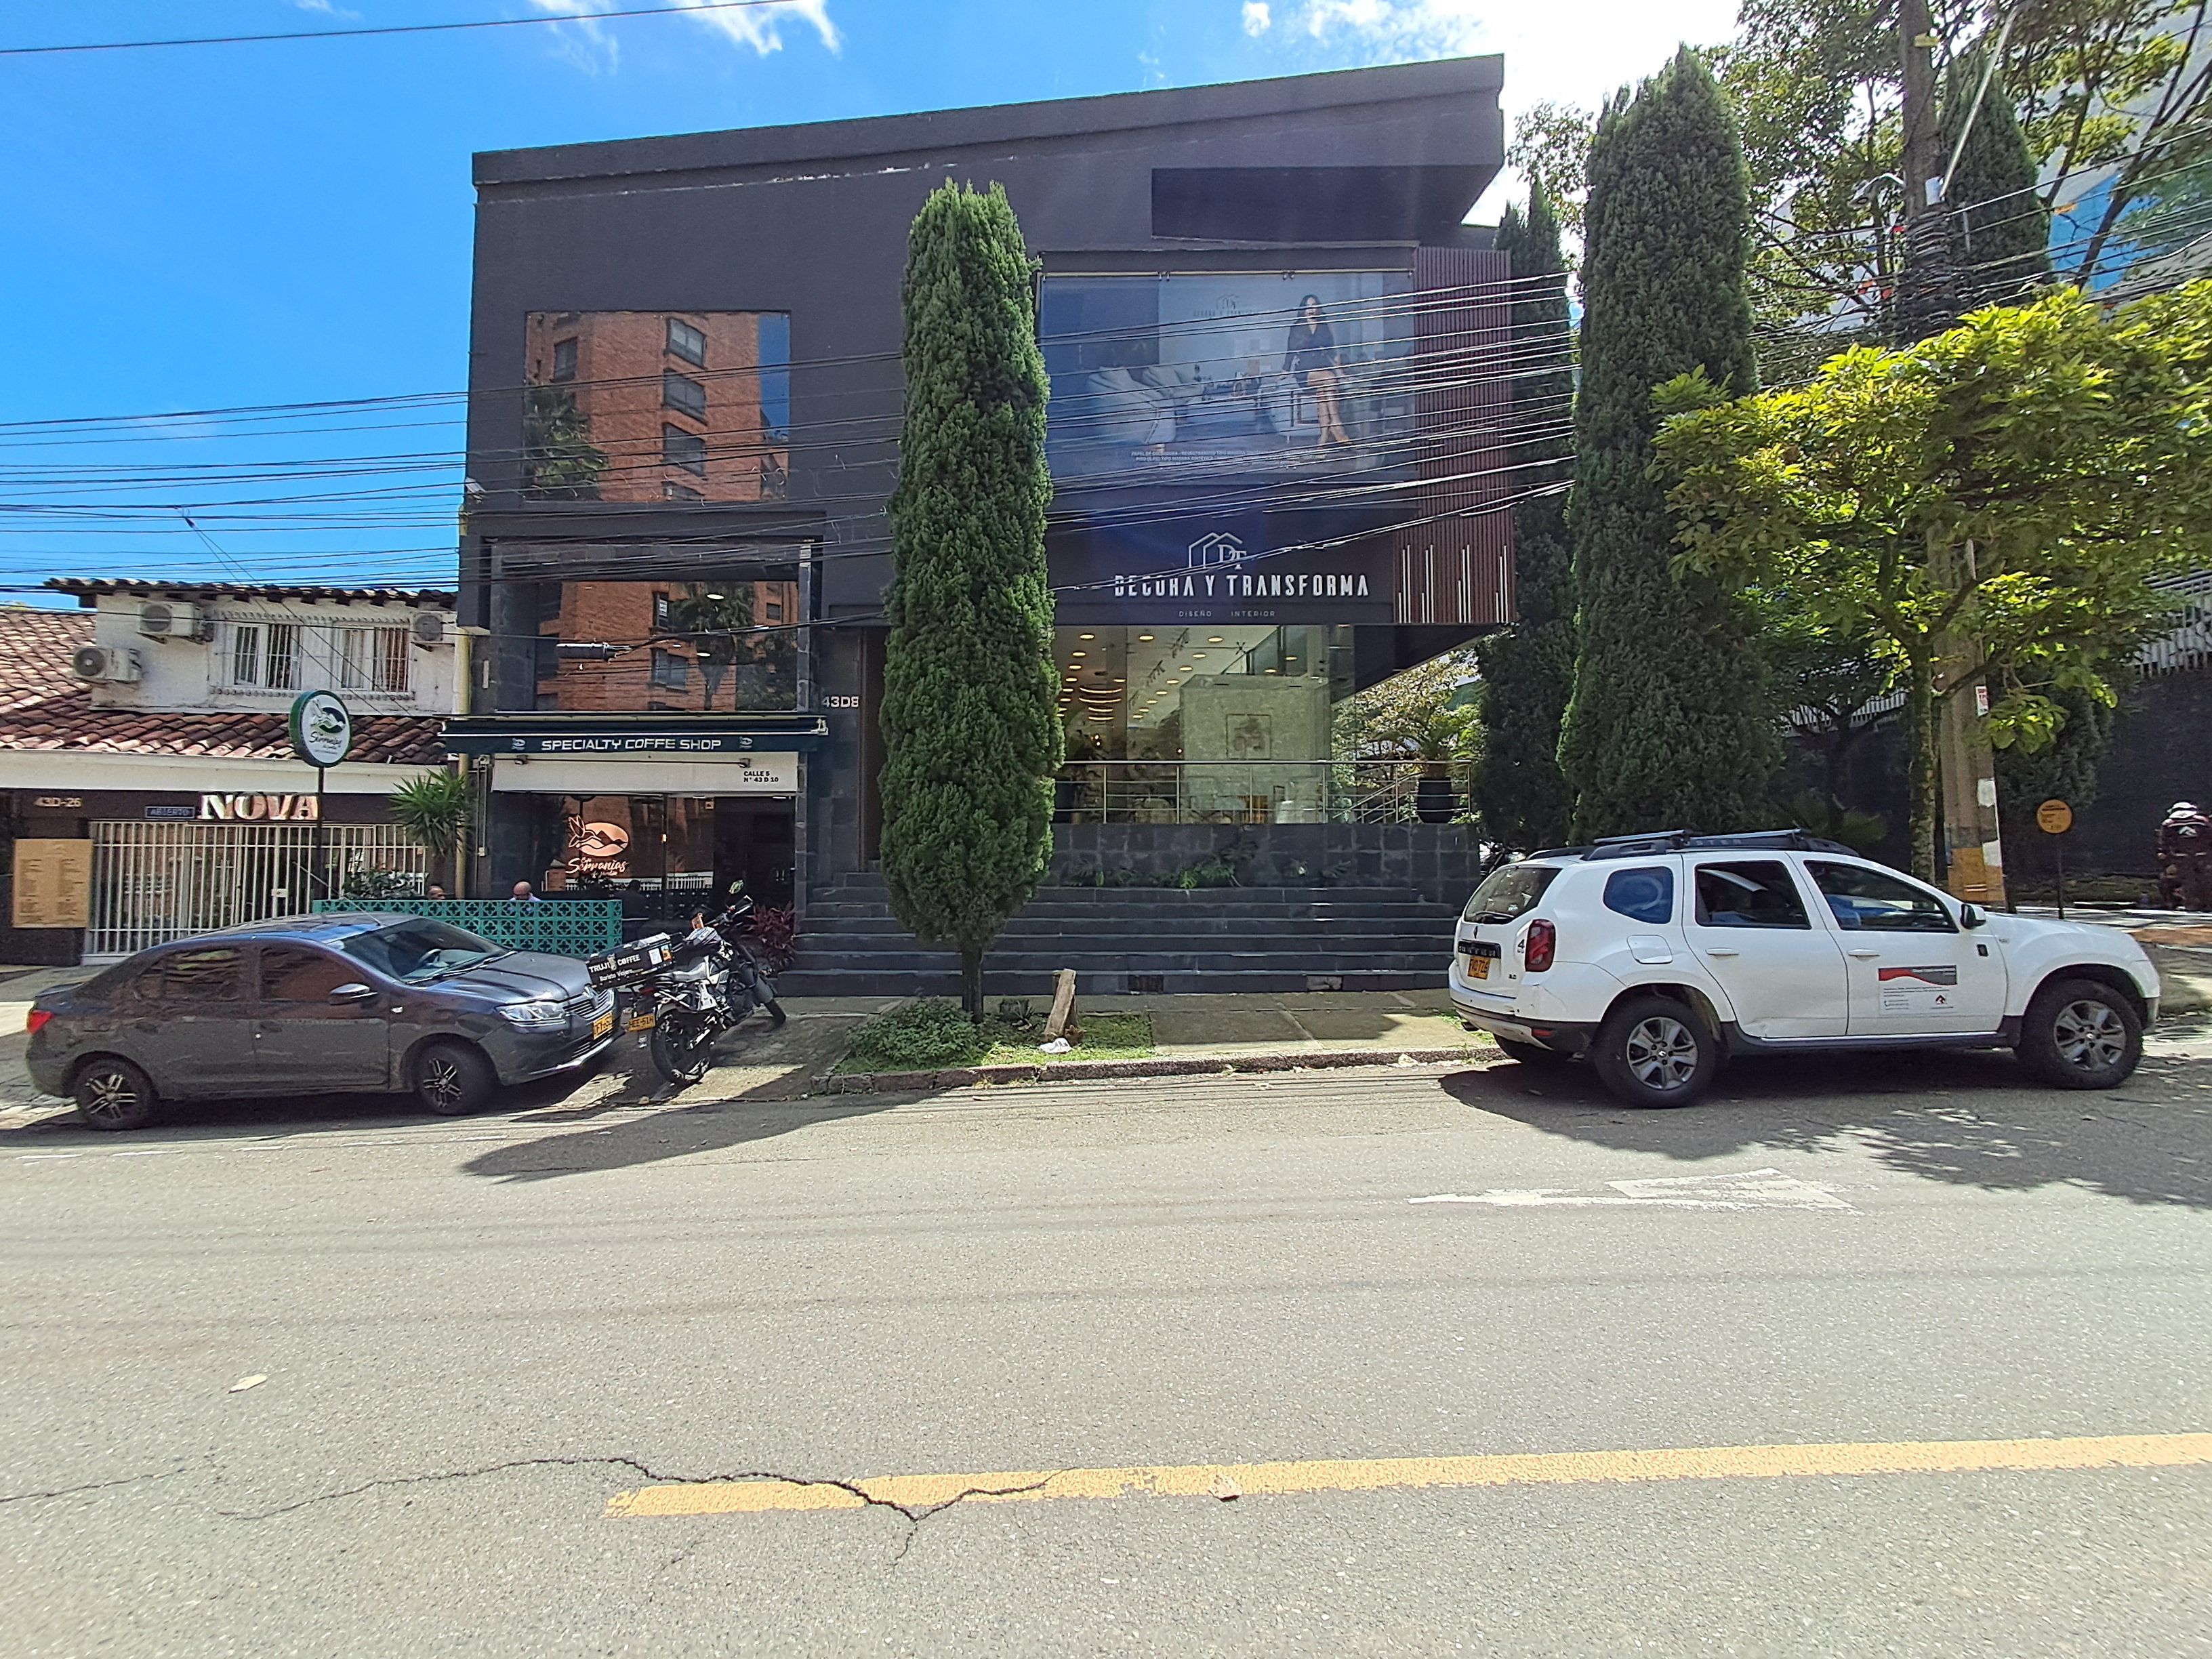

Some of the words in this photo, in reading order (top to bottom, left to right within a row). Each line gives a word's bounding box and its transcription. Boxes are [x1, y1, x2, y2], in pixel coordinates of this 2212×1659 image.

[1204, 575, 1216, 596] Y
[1226, 575, 1369, 597] TRANSFORMA
[541, 739, 621, 750] SPECIALTY
[625, 739, 676, 750] COFFE
[679, 739, 722, 750] SHOP
[197, 792, 319, 821] NOVA
[617, 954, 641, 966] COFFEE
